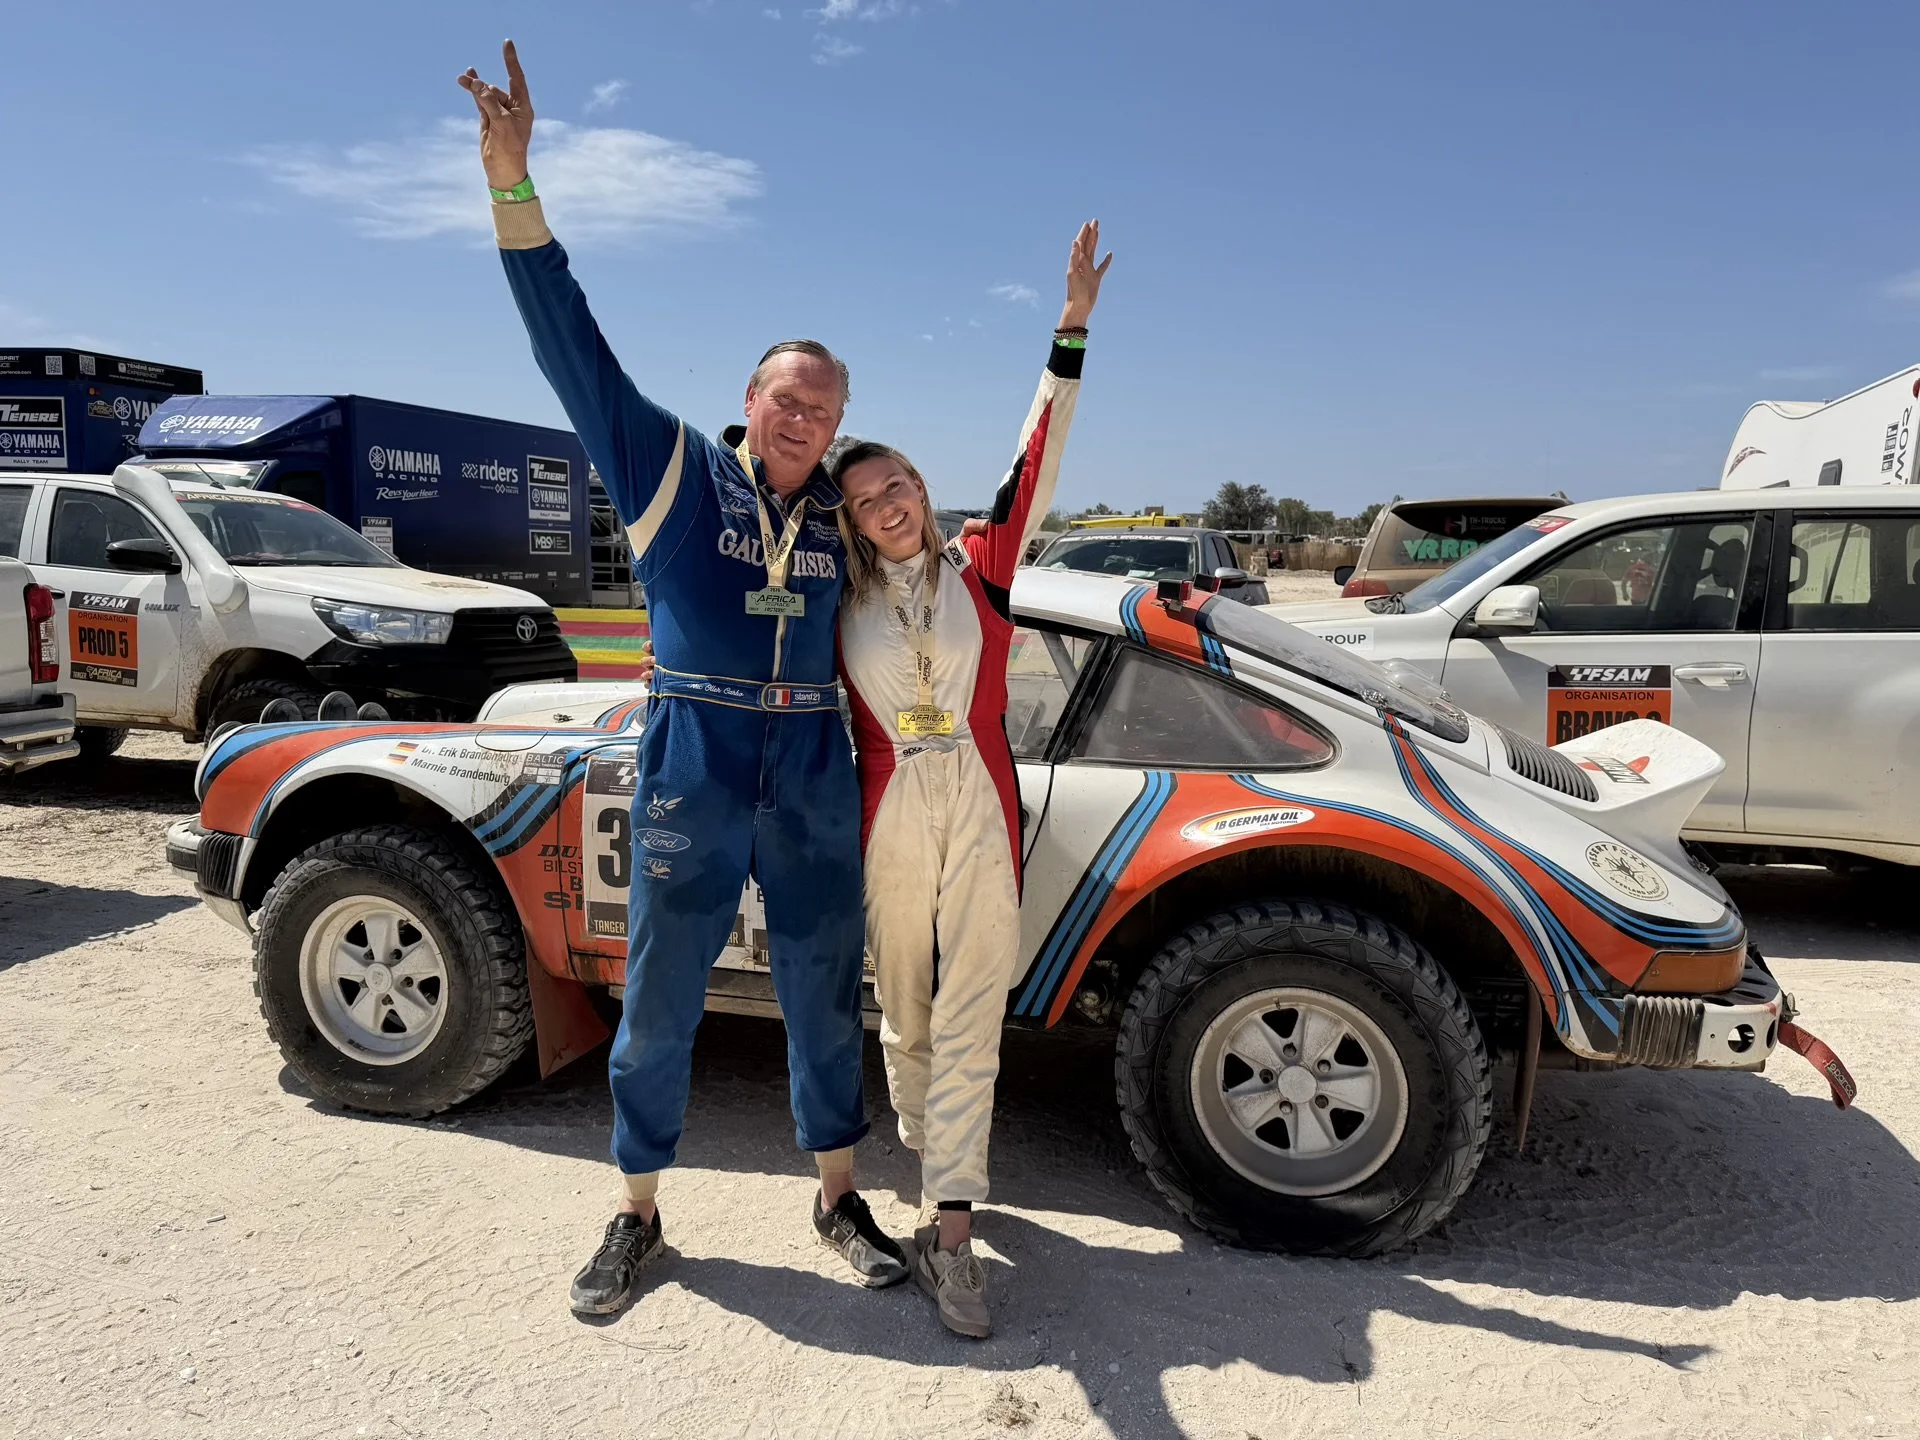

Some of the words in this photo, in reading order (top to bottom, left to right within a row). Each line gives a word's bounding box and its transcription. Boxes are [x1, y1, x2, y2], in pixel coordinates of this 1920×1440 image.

[182, 416, 264, 430] YAMAHA
[12, 434, 60, 448] YAMAHA
[386, 448, 442, 476] YAMAHA
[375, 472, 438, 482] RACING
[480, 460, 518, 483] riders
[540, 490, 568, 505] YAMAHA
[92, 596, 128, 608] FSAM
[756, 594, 796, 604] AFRICA
[78, 612, 128, 624] ORGANISATION
[78, 626, 116, 657] PROD
[119, 631, 128, 658] 5
[1318, 634, 1366, 644] ROUP
[92, 667, 122, 678] AFRICA
[1588, 668, 1652, 681] FSAM
[1565, 691, 1655, 700] ORGANISATION
[908, 714, 945, 722] AFRICA
[438, 746, 458, 758] Erik
[460, 748, 520, 765] Brandenburg
[527, 754, 564, 764] BALTIC
[410, 758, 447, 774] Marnie
[449, 766, 510, 786] Brandenburg
[1228, 812, 1279, 828] GERMAN
[1280, 812, 1299, 820] OIL
[643, 830, 678, 848] Ford
[1589, 844, 1608, 868] DESERT
[594, 920, 625, 934] TANGER
